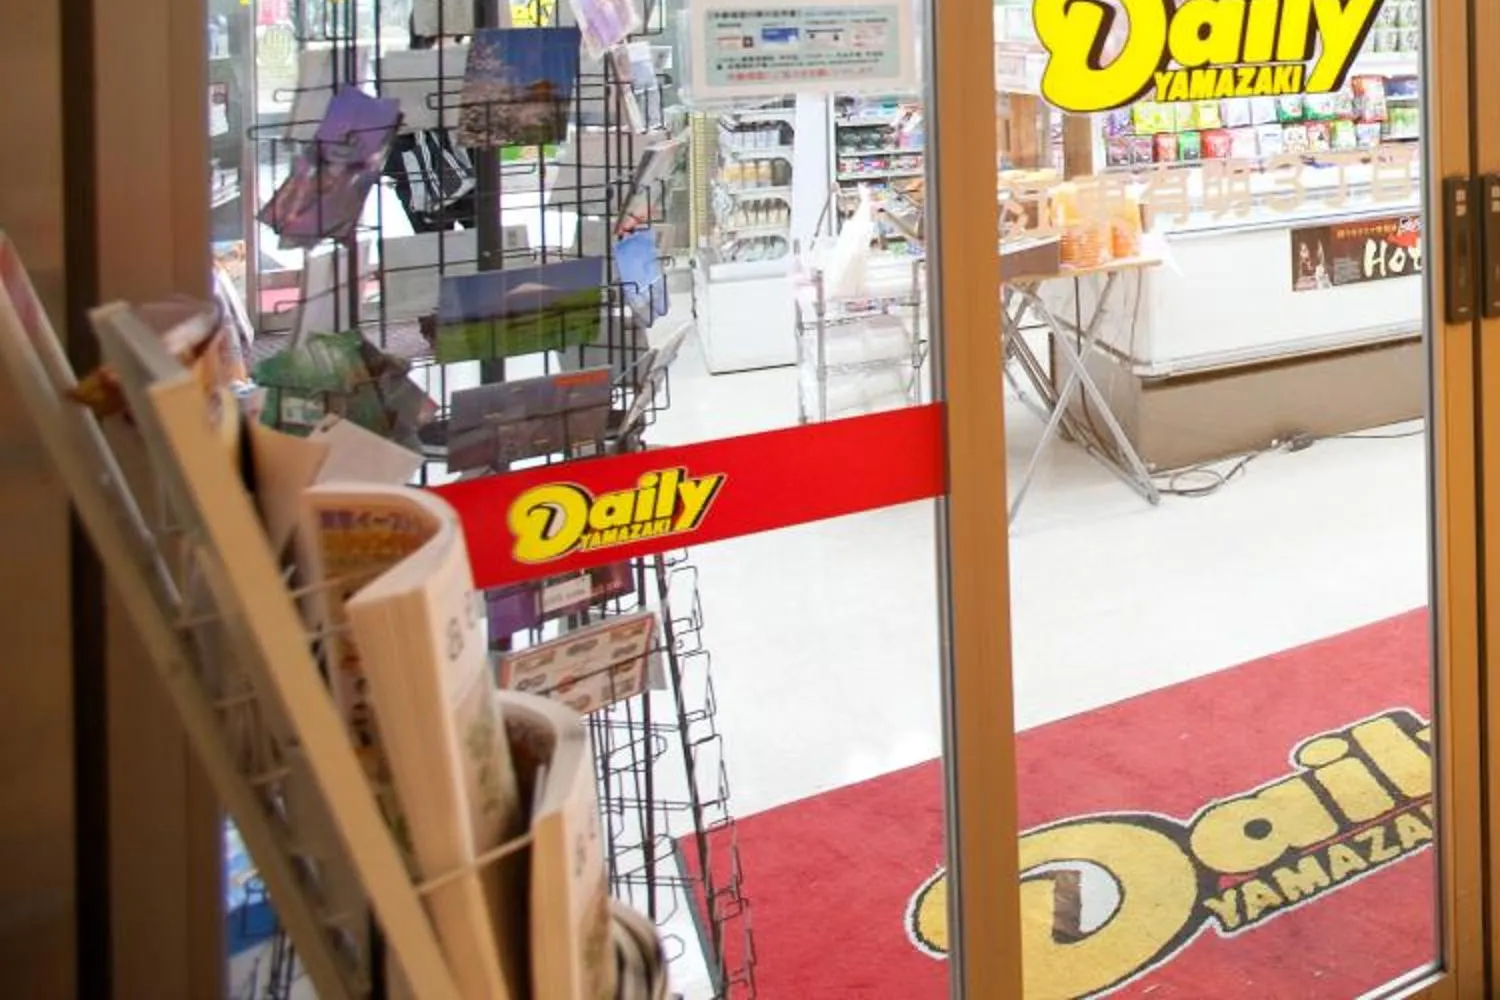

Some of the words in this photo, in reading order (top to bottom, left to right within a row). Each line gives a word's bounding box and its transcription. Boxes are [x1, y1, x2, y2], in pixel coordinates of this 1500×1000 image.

[1154, 64, 1308, 102] YAMAZAKI
[508, 466, 728, 564] Daily
[580, 518, 673, 549] YAMAZAKI
